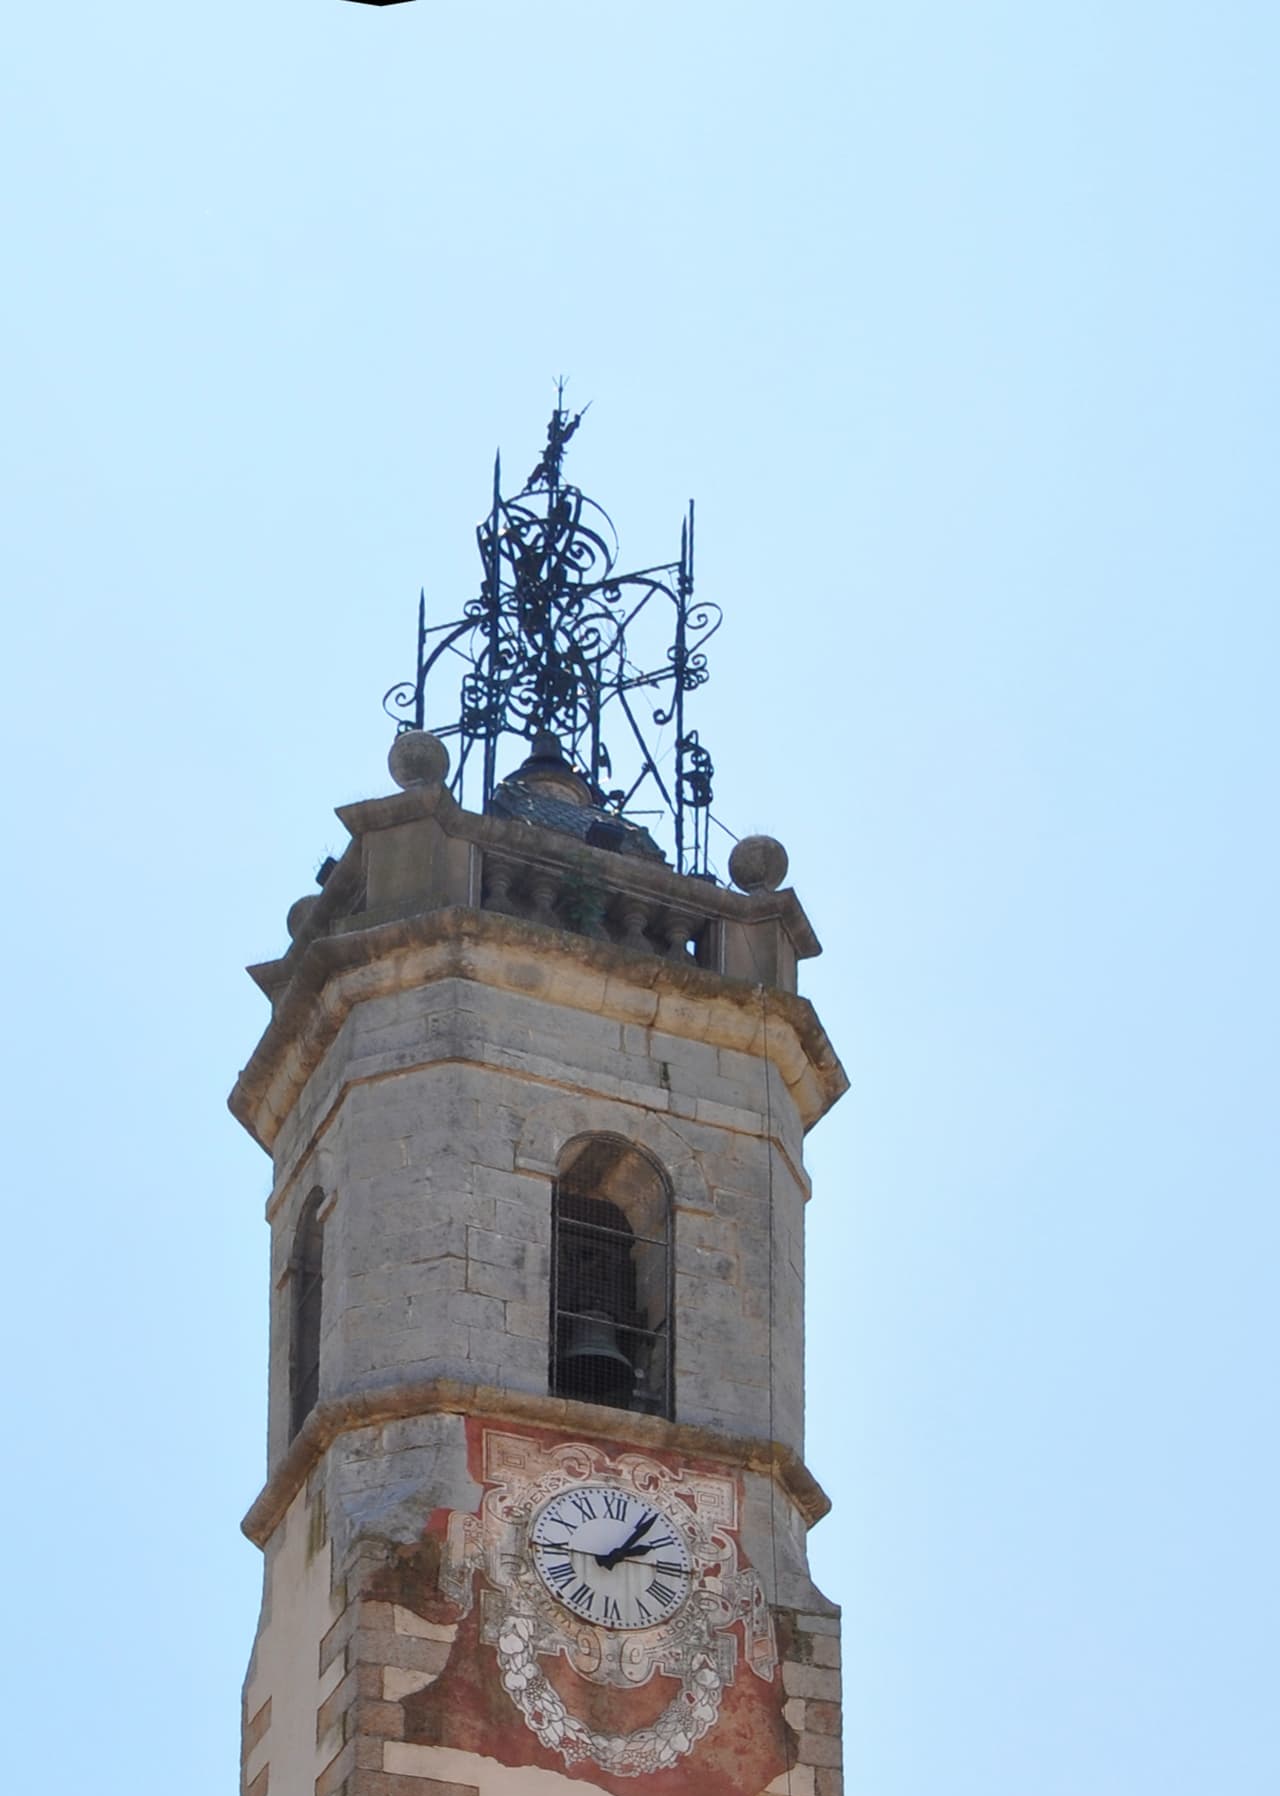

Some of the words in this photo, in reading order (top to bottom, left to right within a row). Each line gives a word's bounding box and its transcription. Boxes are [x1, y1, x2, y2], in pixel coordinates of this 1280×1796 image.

[571, 1496, 598, 1523] XI
[603, 1495, 627, 1522] XII
[550, 1511, 578, 1535] X
[543, 1537, 569, 1556] IX
[649, 1536, 674, 1549] II
[523, 1477, 572, 1513] PENSA
[655, 1609, 696, 1641] MORT
[656, 1560, 682, 1578] III
[548, 1563, 577, 1590] VIII
[570, 1583, 595, 1611] VII
[646, 1579, 677, 1608] IIII
[603, 1596, 621, 1621] VI
[635, 1597, 652, 1619] V
